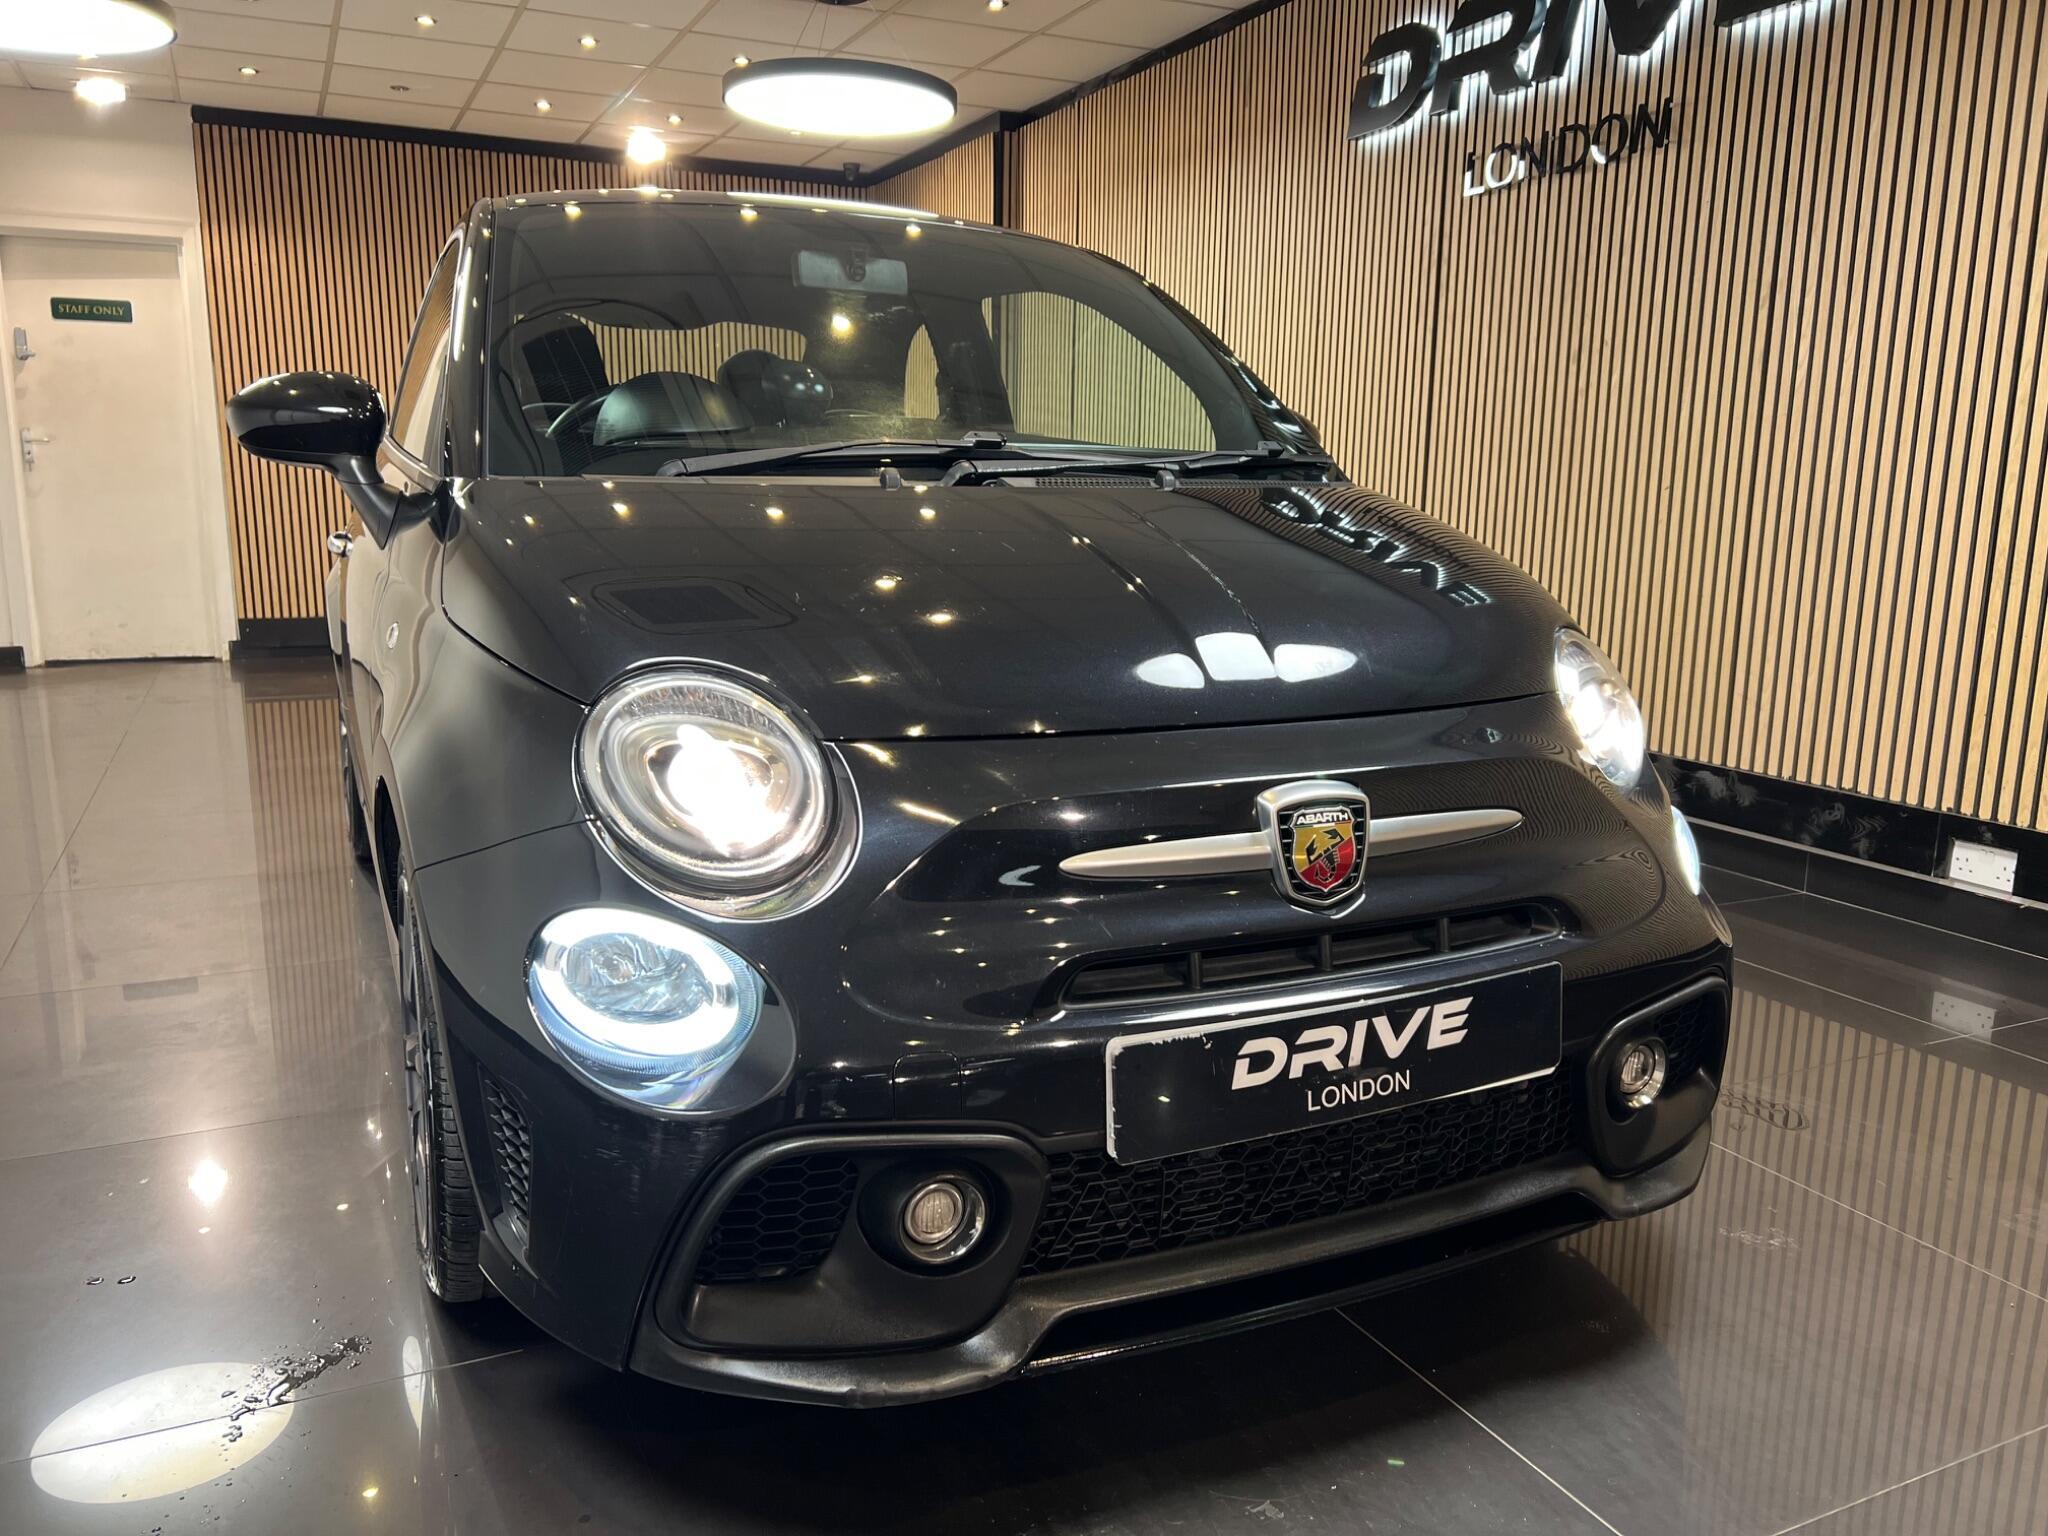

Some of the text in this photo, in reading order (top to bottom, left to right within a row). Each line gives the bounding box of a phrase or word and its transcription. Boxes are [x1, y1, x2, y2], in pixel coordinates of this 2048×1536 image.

[1346, 0, 1815, 140] DRI
[1463, 96, 1674, 197] LONDON
[58, 303, 125, 316] STAFF ONLY
[1297, 812, 1348, 824] ABARTH
[1231, 996, 1474, 1090] DRIVE
[1306, 1070, 1411, 1112] LONDON
